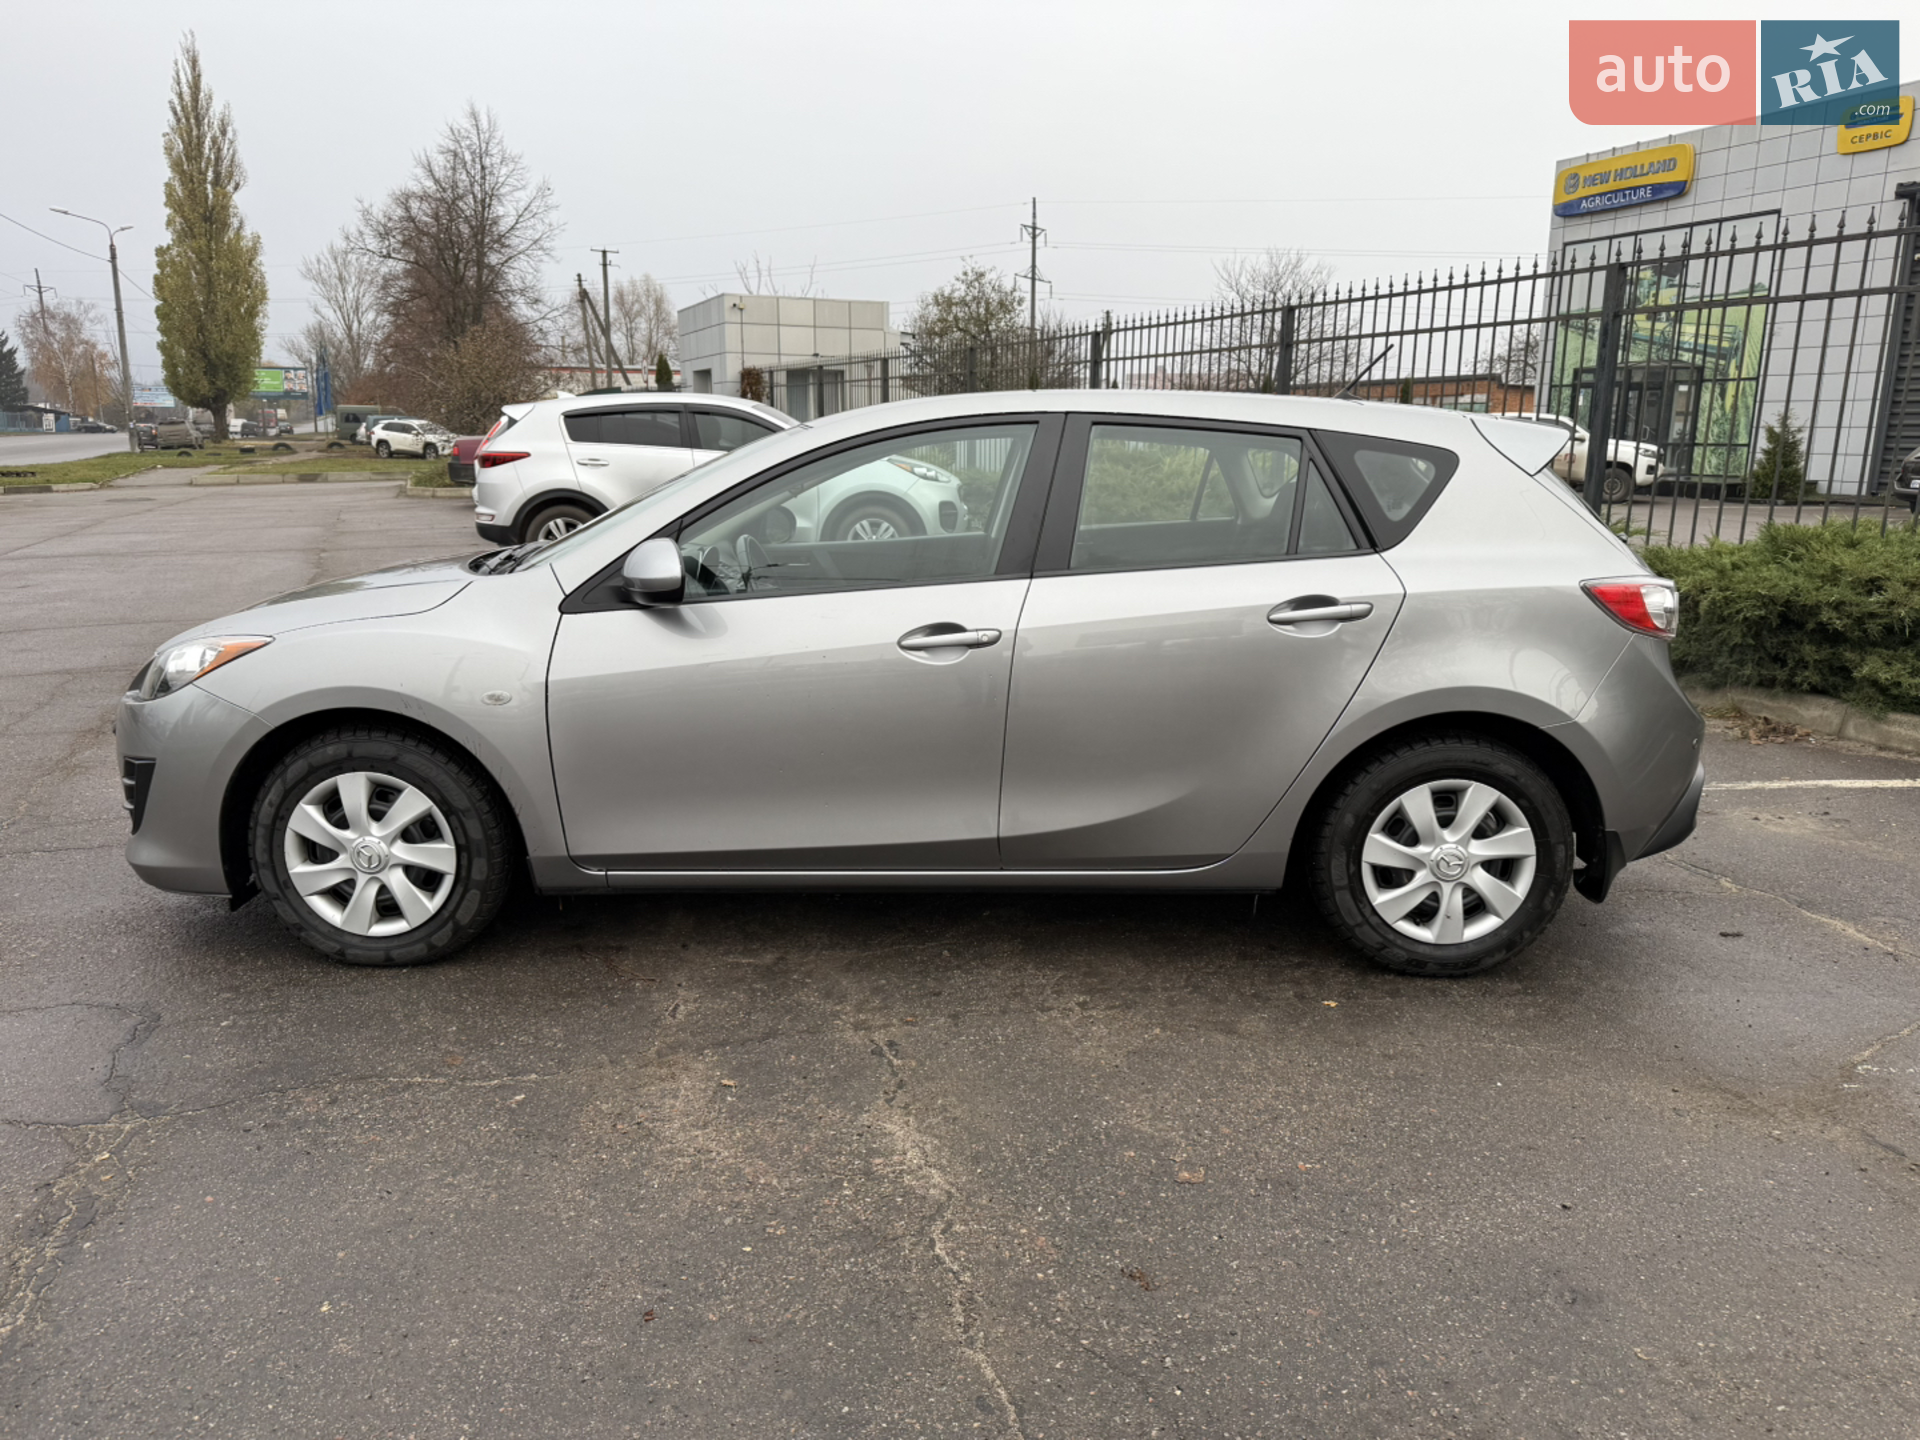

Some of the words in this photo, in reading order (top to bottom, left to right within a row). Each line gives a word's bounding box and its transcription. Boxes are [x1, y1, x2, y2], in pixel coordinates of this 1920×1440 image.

[1850, 129, 1893, 145] СЕРВІС
[1582, 170, 1612, 188] NEW
[1613, 157, 1678, 182] HOLLAND
[1580, 186, 1653, 209] AGRICULTURE
